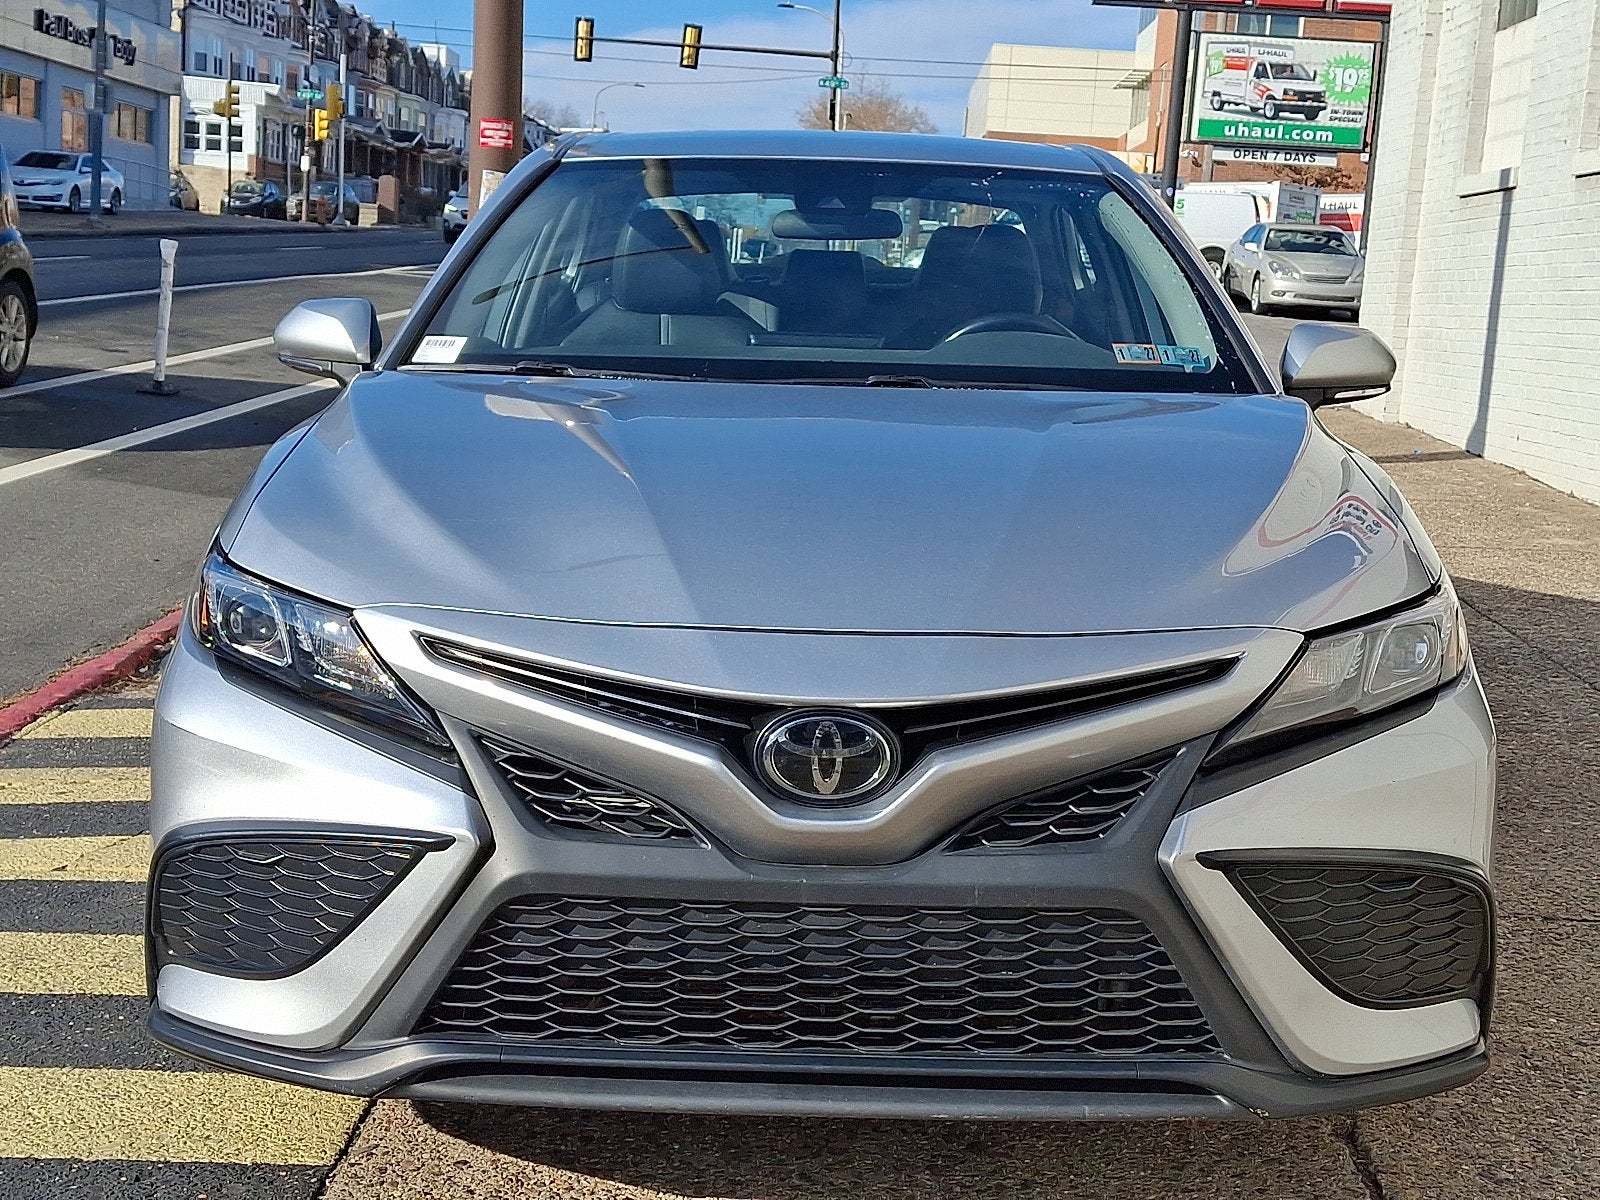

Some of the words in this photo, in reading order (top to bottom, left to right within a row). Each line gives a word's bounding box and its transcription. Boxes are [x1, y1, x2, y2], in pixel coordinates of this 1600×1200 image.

[1257, 48, 1288, 58] U-HAUL
[1330, 108, 1364, 116] IN-TOWN
[1223, 122, 1334, 142] uhaul.com
[1233, 148, 1268, 160] OPEN
[1272, 151, 1281, 161] 7
[1283, 151, 1317, 163] DAYS
